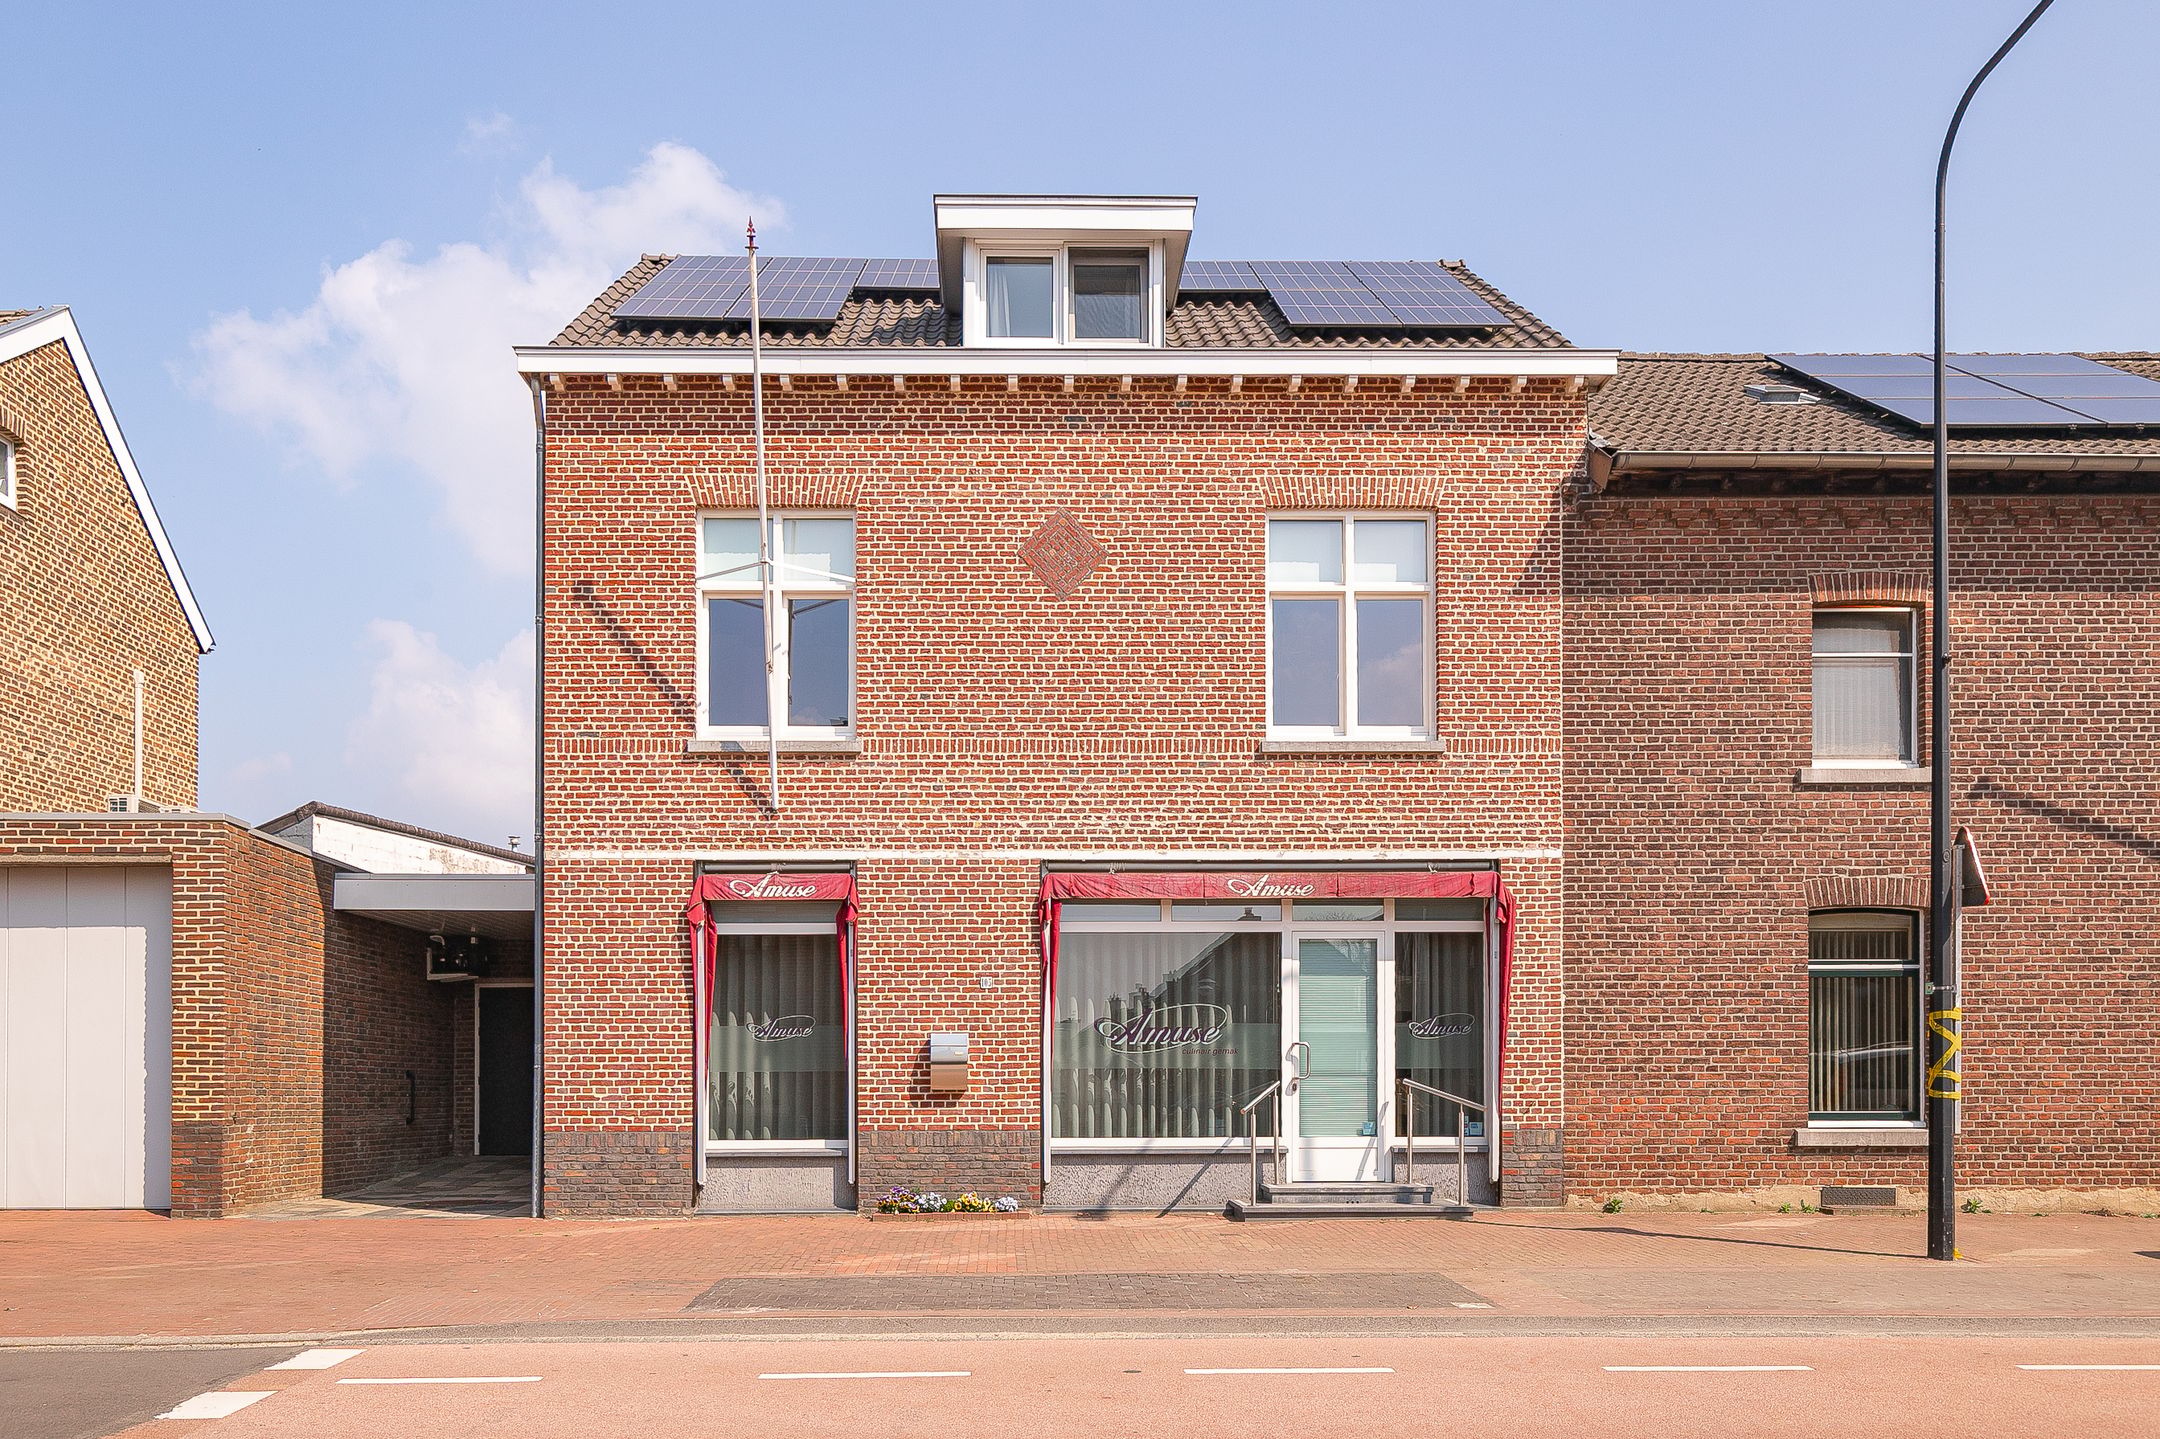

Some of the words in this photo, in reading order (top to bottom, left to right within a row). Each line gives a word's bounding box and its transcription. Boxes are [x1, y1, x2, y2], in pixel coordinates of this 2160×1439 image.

[729, 871, 818, 898] Amuse
[1227, 874, 1316, 897] Amuse
[745, 1016, 815, 1039] Amuse
[1093, 1007, 1223, 1046] Amuse
[1406, 1015, 1473, 1036] Amuse
[1212, 1048, 1239, 1057] gemak
